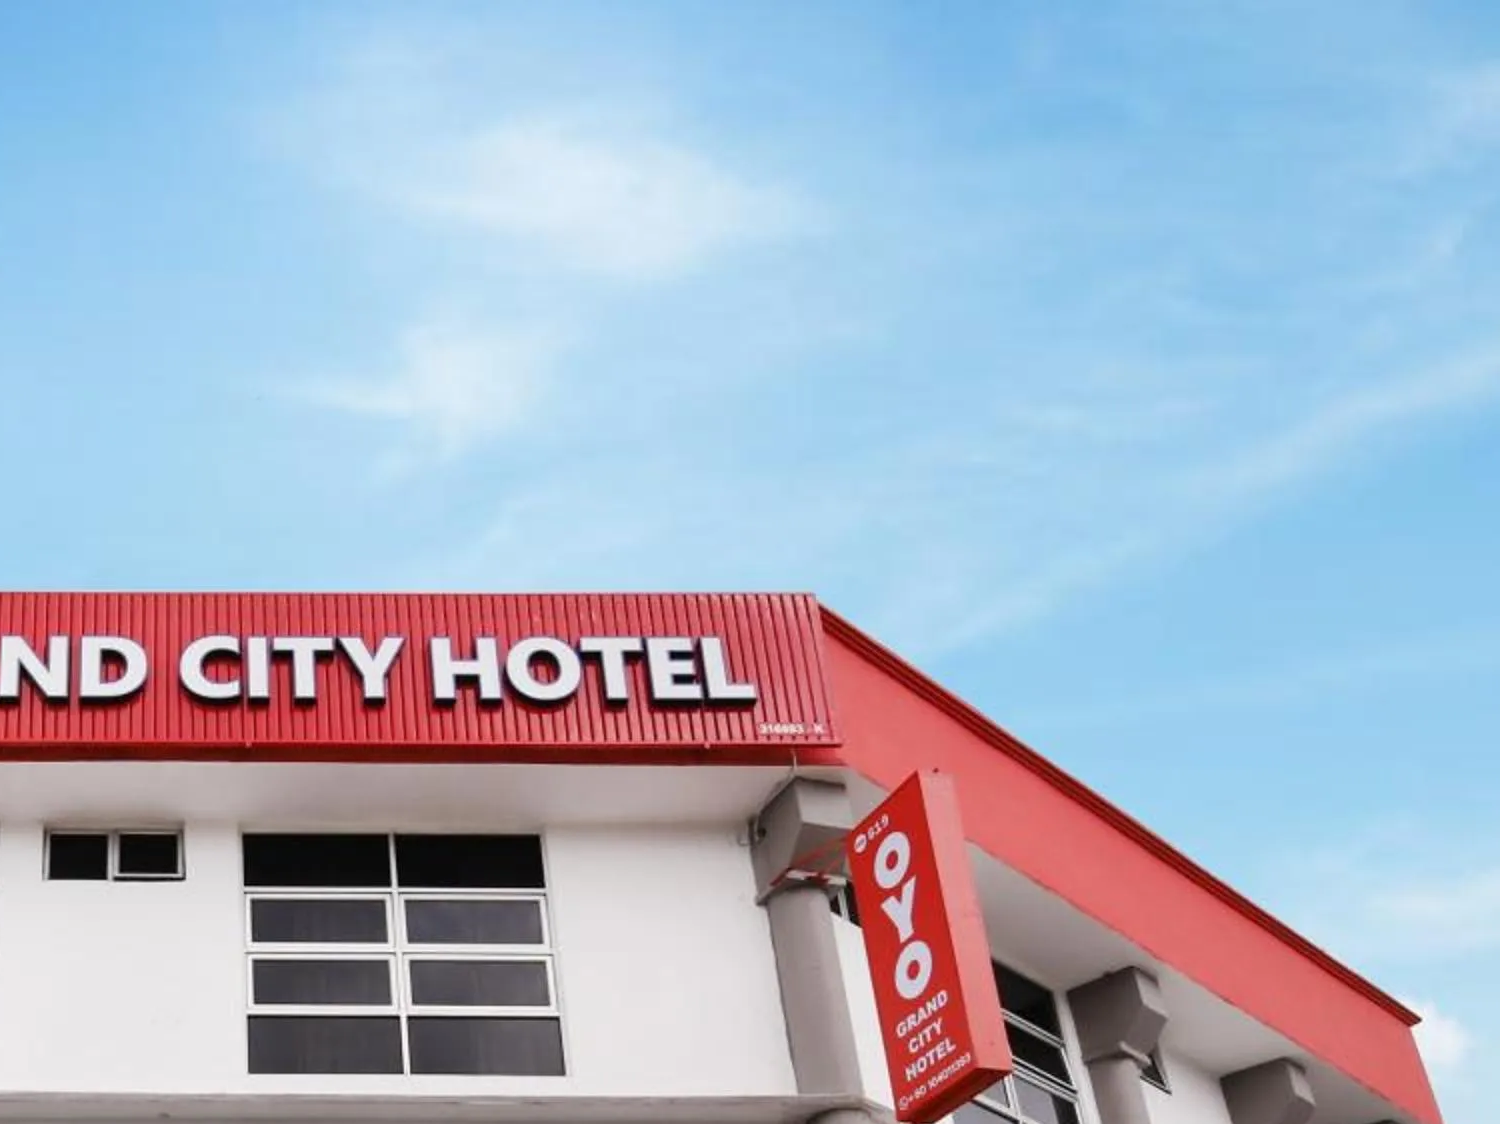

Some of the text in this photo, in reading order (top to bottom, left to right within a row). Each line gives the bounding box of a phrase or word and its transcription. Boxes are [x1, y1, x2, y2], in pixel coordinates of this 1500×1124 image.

[179, 634, 404, 700] CITY
[429, 635, 758, 701] HOTEL
[873, 831, 933, 1000] OYO
[896, 989, 948, 1038] GRAND
[908, 1017, 943, 1053] CITY
[905, 1037, 956, 1082] HOTEL
